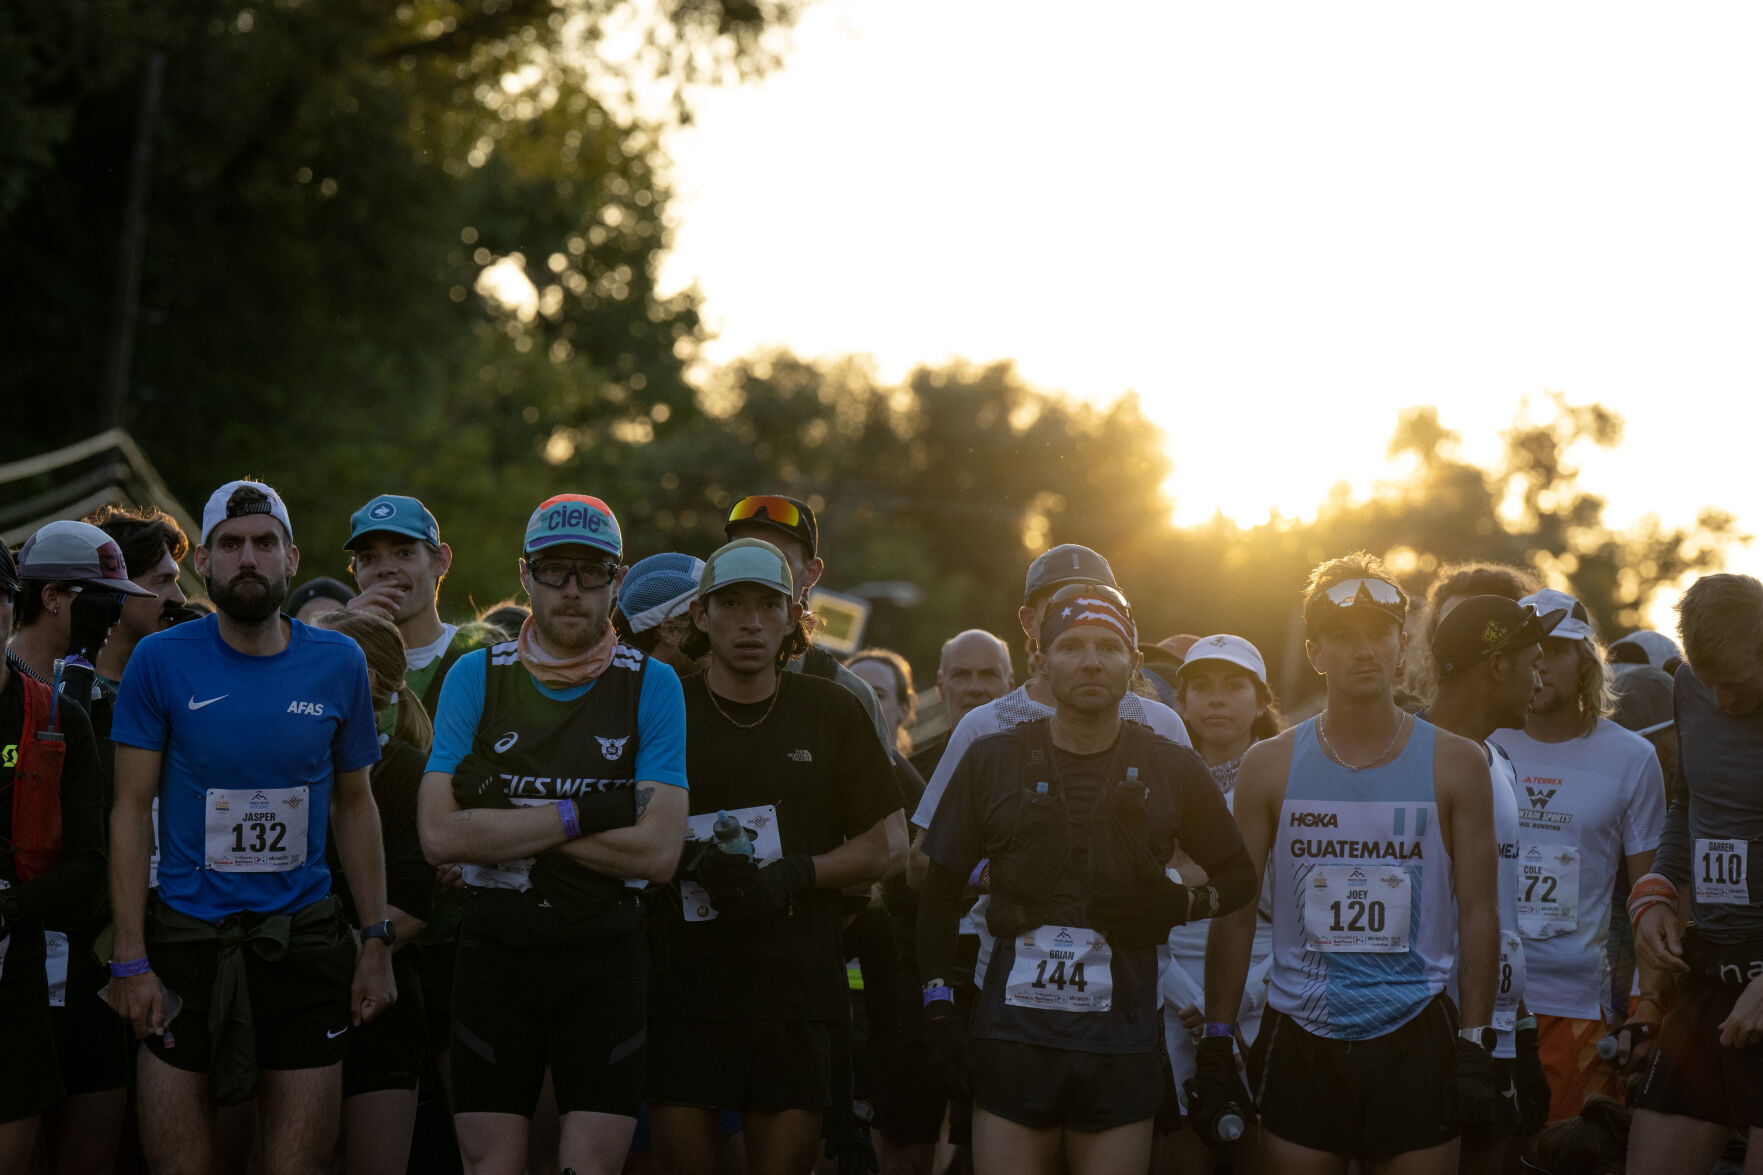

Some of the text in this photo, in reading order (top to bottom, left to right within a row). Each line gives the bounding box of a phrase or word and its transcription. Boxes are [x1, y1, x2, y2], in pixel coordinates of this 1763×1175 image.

[548, 505, 601, 533] ciele
[287, 700, 324, 716] AFAS
[555, 777, 634, 797] WEST
[242, 812, 276, 822] JASPER
[1290, 812, 1338, 828] HOKA
[231, 822, 287, 853] 132
[1708, 842, 1735, 852] DARREN
[1290, 839, 1423, 859] GUATEMALA
[1523, 865, 1543, 875] COLE
[1703, 852, 1742, 885] 110
[1346, 890, 1369, 900] JOEY
[1517, 875, 1558, 903] 72
[1329, 900, 1386, 933] 120
[1049, 949, 1075, 961] BRIAN
[1031, 960, 1088, 993] 144
